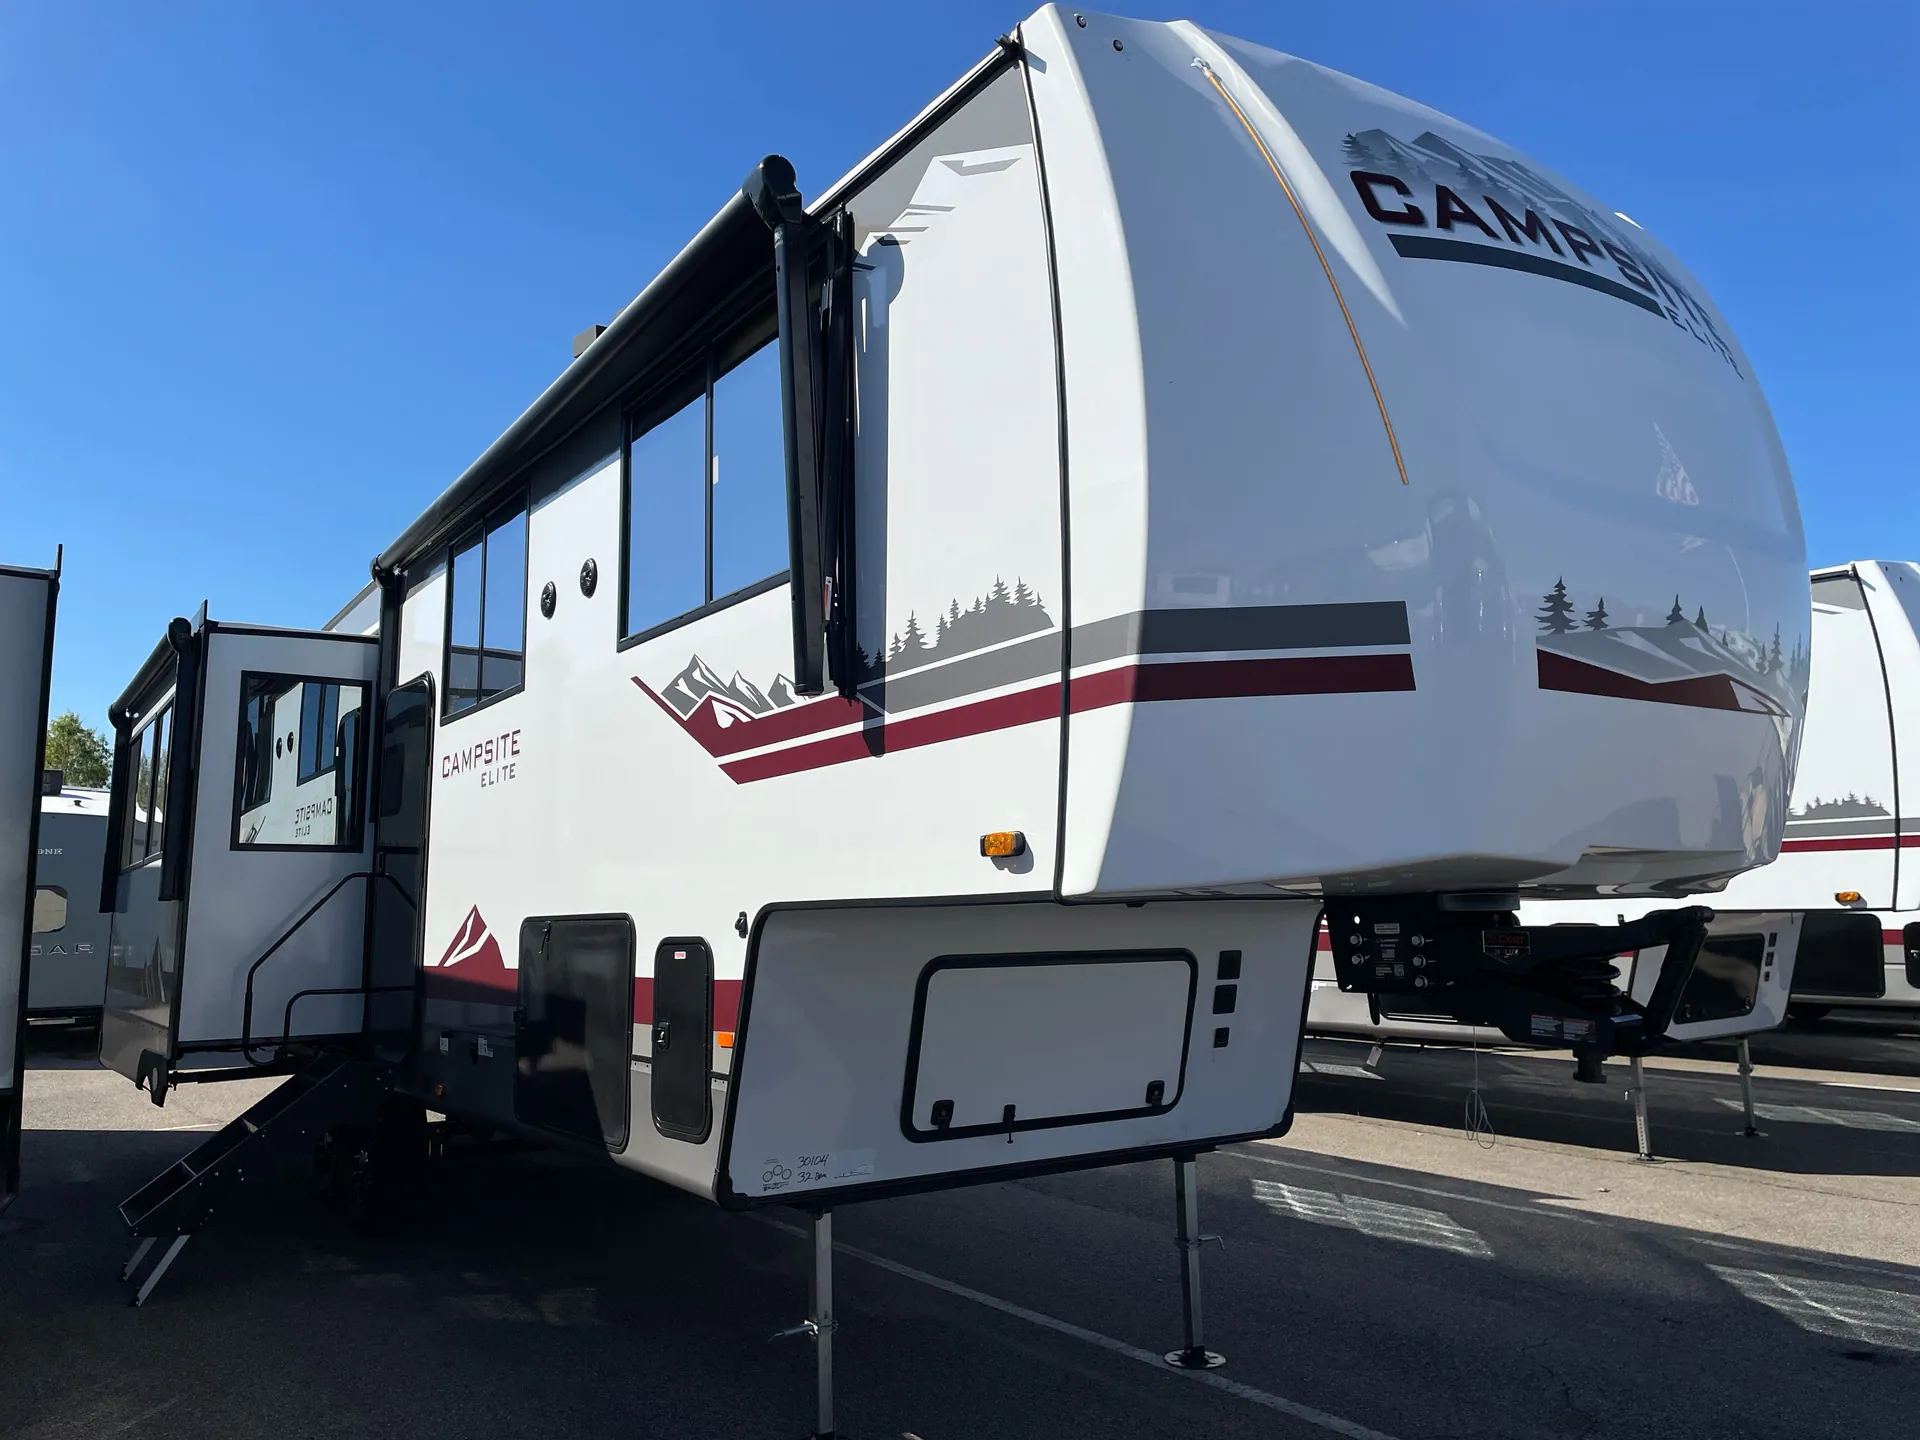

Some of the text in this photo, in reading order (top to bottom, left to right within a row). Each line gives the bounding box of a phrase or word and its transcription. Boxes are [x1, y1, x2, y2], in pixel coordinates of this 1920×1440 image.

[1350, 170, 1733, 356] CAMPSITE
[1663, 305, 1745, 381] ELITE
[442, 729, 521, 779] CAMPSITE
[480, 762, 516, 788] ELITE
[797, 1153, 830, 1169] 30104
